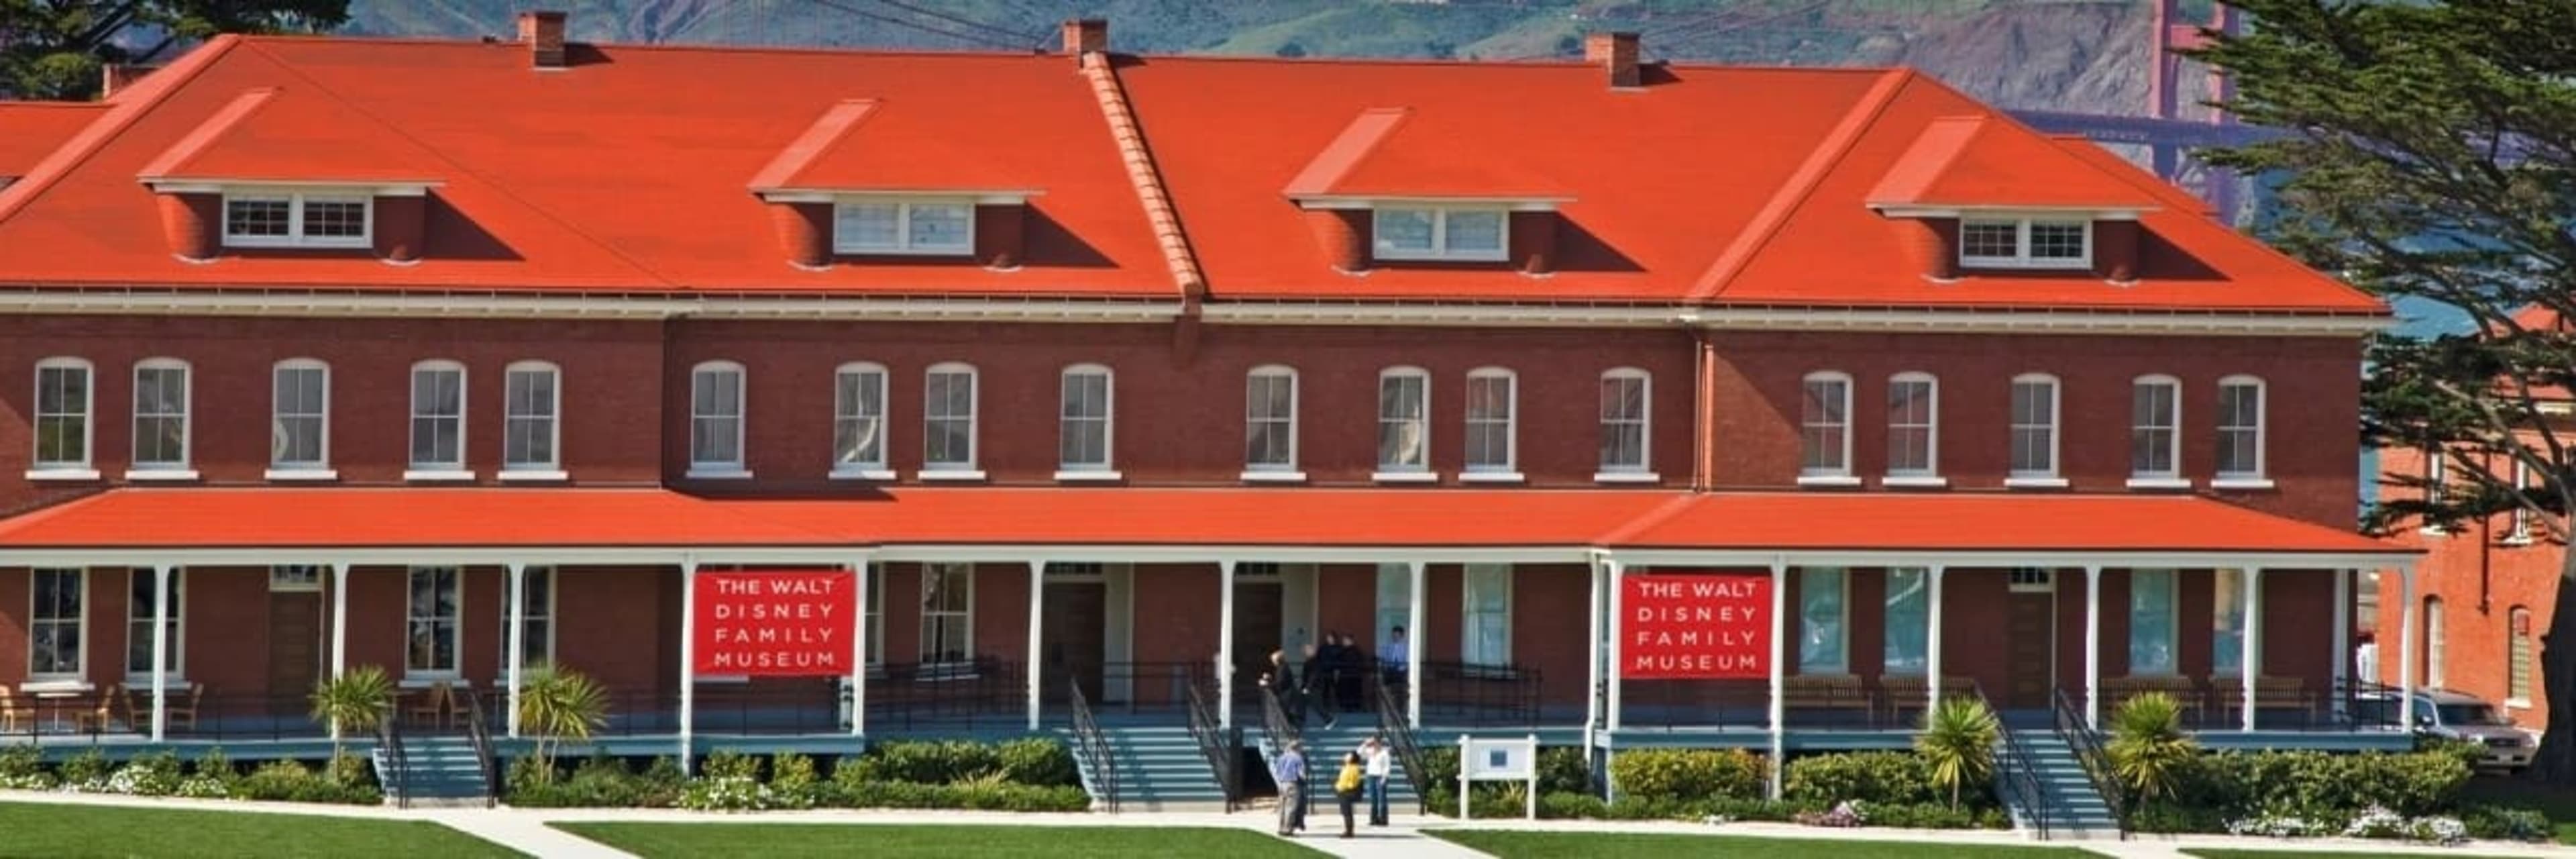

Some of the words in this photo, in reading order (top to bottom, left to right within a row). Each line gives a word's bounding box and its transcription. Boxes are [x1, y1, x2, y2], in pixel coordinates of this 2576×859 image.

[716, 579, 761, 595] THE
[770, 579, 834, 595] WALT
[1639, 583, 1682, 597] THE
[1693, 583, 1756, 597] WALT
[716, 603, 833, 619] DISNEY
[1638, 607, 1756, 622] DISNEY
[715, 627, 833, 643] FAMILY
[1638, 631, 1756, 646] FAMILY
[714, 652, 834, 667] MUSEUM
[1636, 655, 1756, 670] MUSEUM
